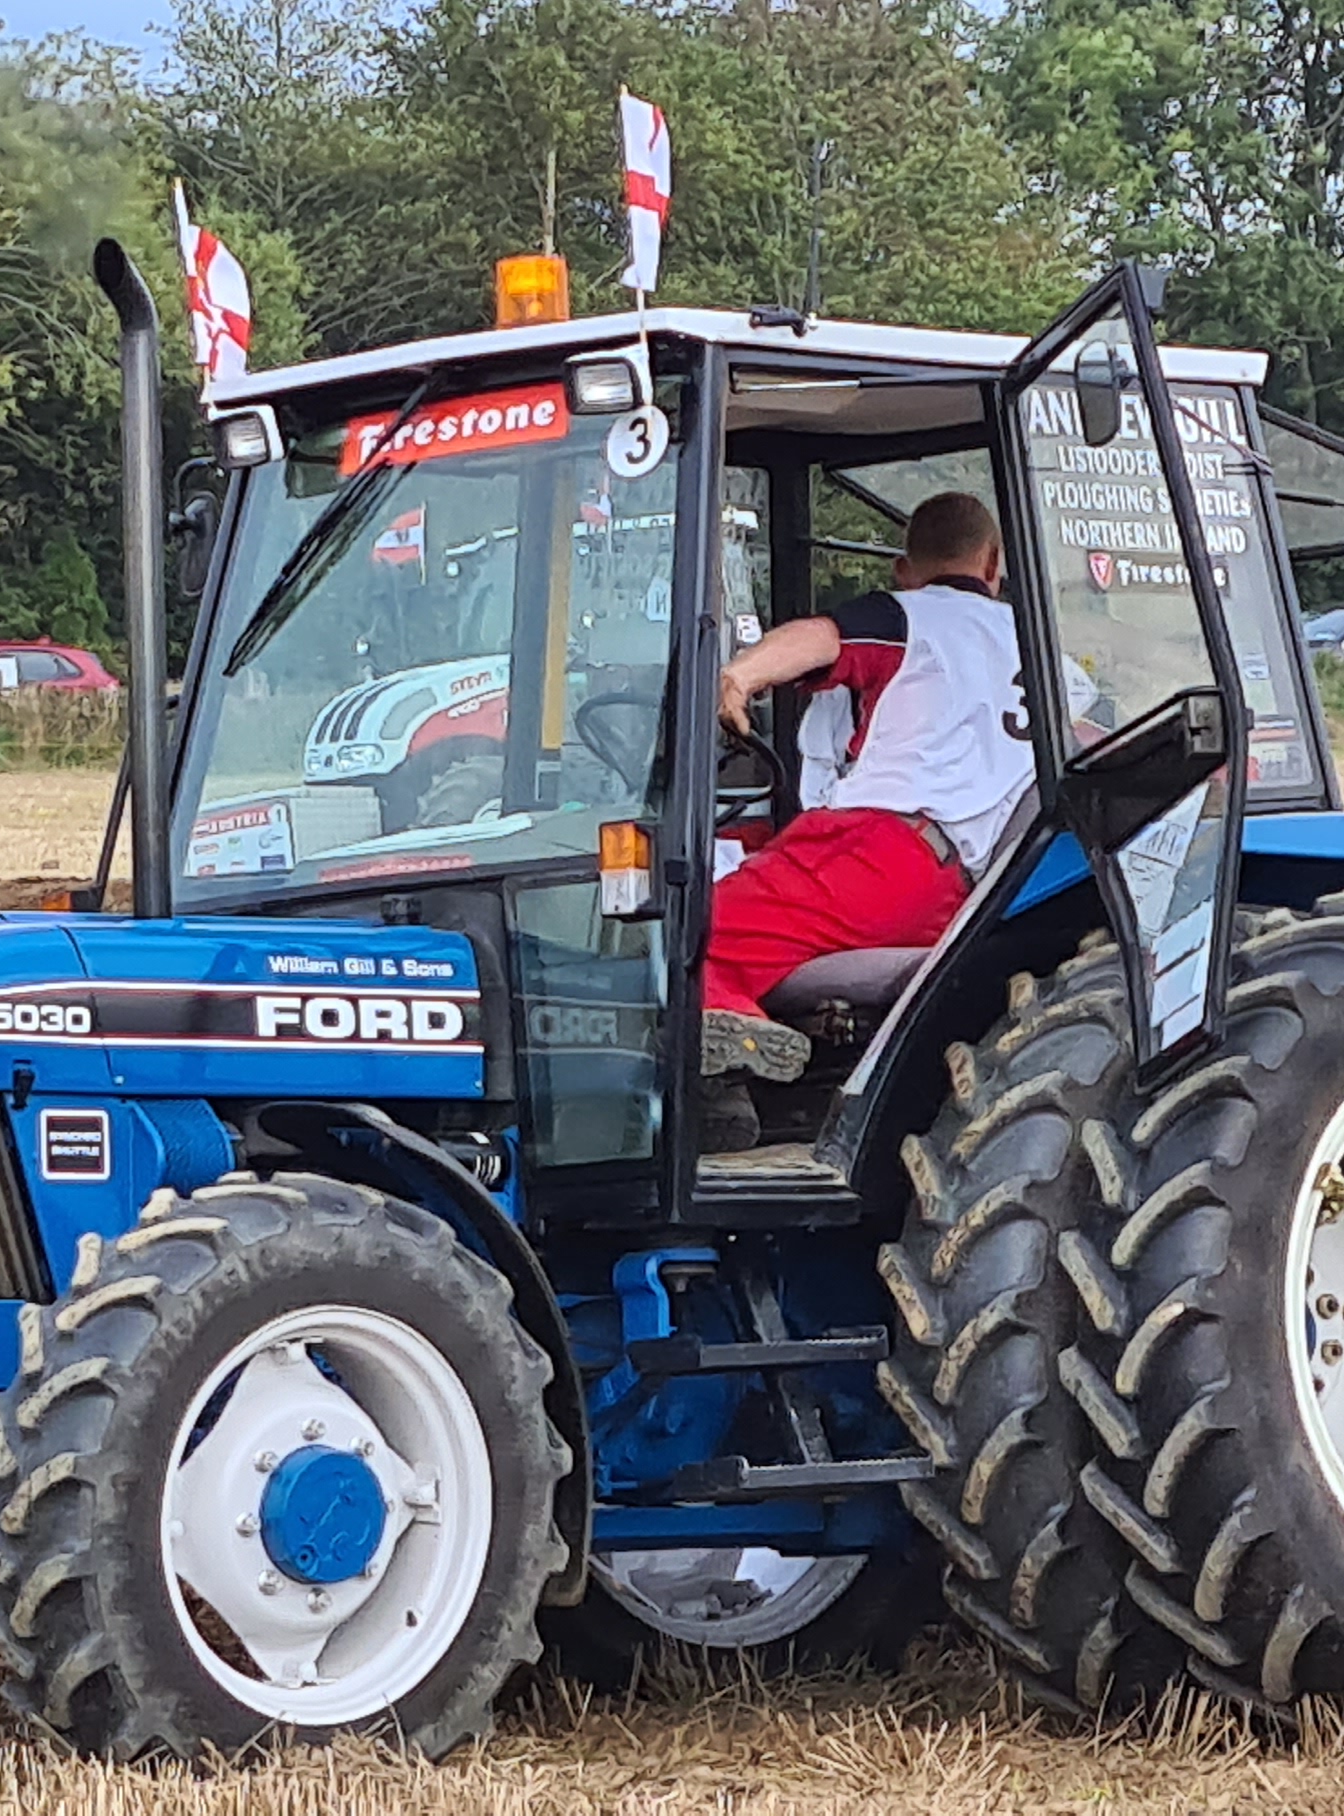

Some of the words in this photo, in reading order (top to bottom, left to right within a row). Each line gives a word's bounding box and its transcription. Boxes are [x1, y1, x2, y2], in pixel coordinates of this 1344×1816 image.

[1173, 397, 1246, 445] GILL
[624, 416, 652, 465] 3
[1185, 452, 1225, 481] DIST
[1042, 480, 1153, 514] PLOUGHING
[1156, 486, 1252, 517] SIETIES
[1060, 516, 1159, 549] NORTHERN
[268, 956, 339, 975] William
[343, 957, 376, 976] Gill
[381, 959, 399, 976] &
[403, 959, 455, 978] Sons
[256, 997, 464, 1041] FORD
